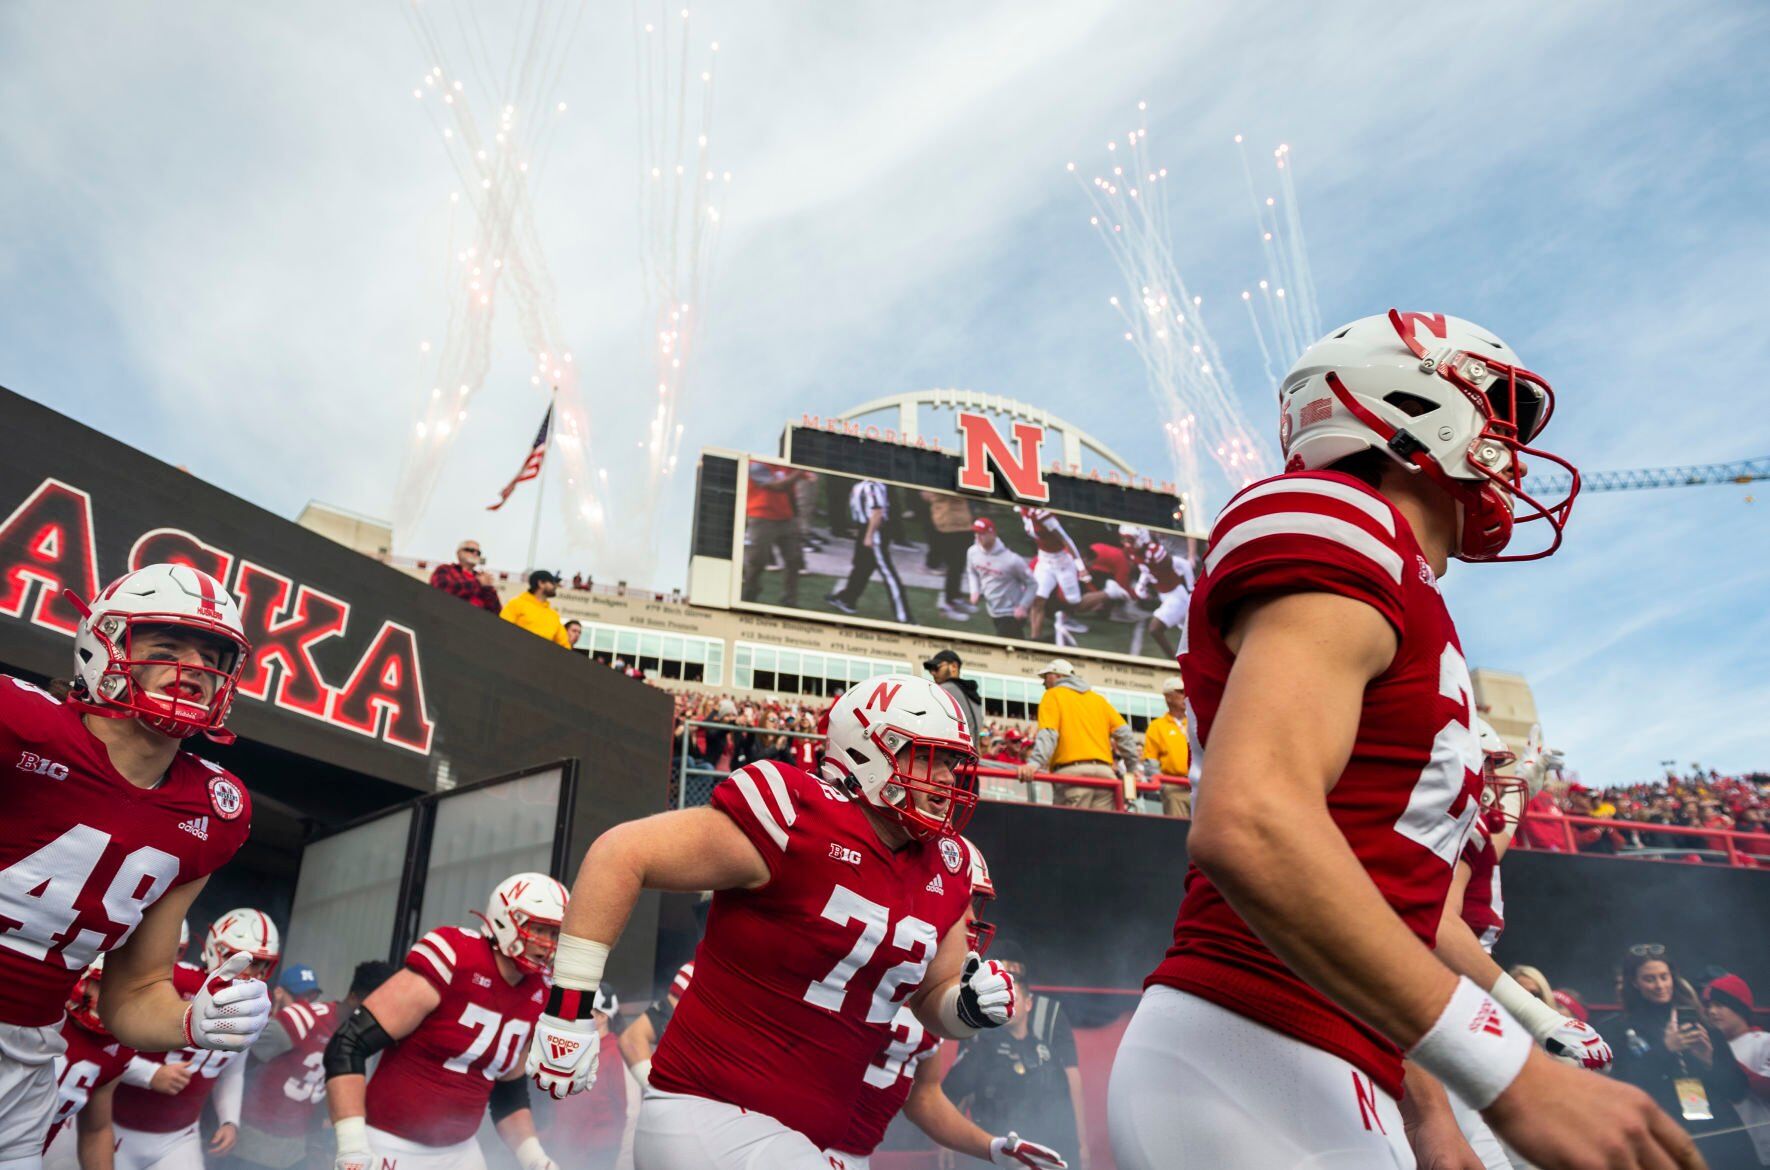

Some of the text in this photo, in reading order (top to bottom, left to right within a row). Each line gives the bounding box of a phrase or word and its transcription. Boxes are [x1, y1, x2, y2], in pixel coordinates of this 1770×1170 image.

[1401, 312, 1447, 338] N
[803, 414, 943, 452] MEMORIAL
[956, 410, 1050, 502] N
[1051, 460, 1177, 492] STADIUM
[197, 606, 223, 620] HUSKERS
[866, 682, 902, 712] N
[803, 743, 812, 763] 1
[178, 822, 208, 841] adidas
[0, 823, 180, 970] 49
[508, 881, 529, 900] N
[803, 883, 938, 1024] 72
[442, 1002, 531, 1081] 70
[547, 1034, 580, 1049] adidas
[1351, 1070, 1387, 1135] N
